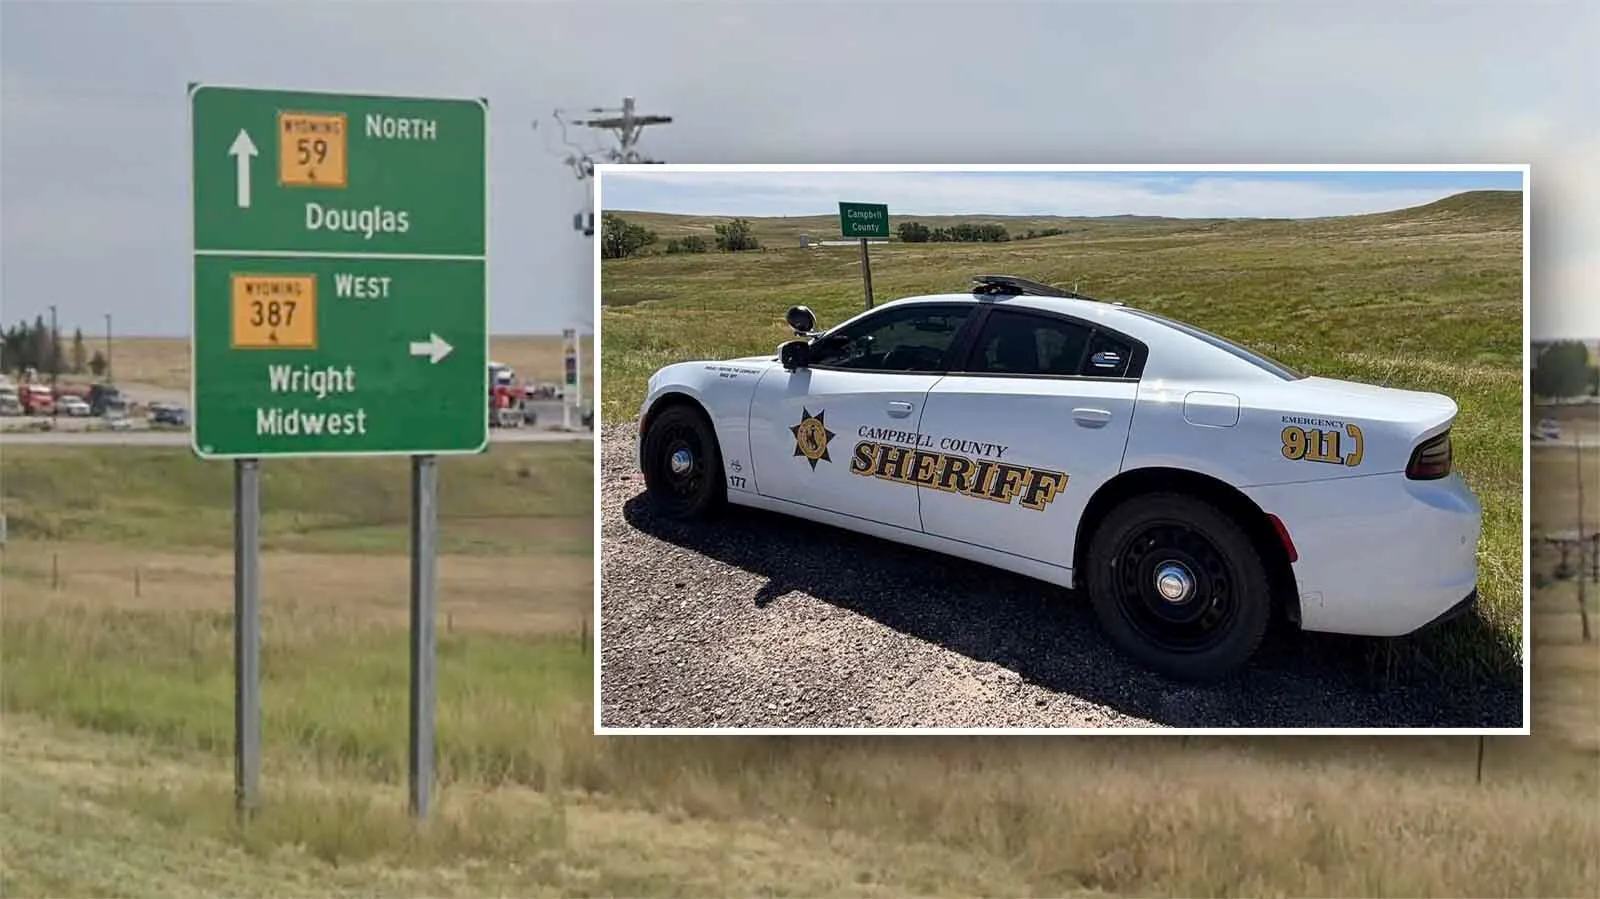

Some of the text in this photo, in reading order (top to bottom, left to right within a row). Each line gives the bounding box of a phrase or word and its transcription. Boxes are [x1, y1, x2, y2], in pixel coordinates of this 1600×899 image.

[365, 114, 437, 141] NORTH
[297, 139, 327, 165] 59
[305, 202, 410, 240] Douglas
[847, 209, 882, 220] Campbell
[852, 222, 880, 233] County
[244, 281, 303, 297] WYOMING
[335, 273, 392, 299] WEST
[250, 300, 297, 327] 387
[269, 364, 356, 399] Wright
[256, 408, 367, 437] Midwest
[1281, 416, 1344, 428] EMERGENCY
[858, 425, 1009, 459] CAMPBELL COUNTY
[1281, 426, 1344, 465] 911
[730, 476, 746, 488] 177
[850, 440, 1069, 511] SHERIFF
